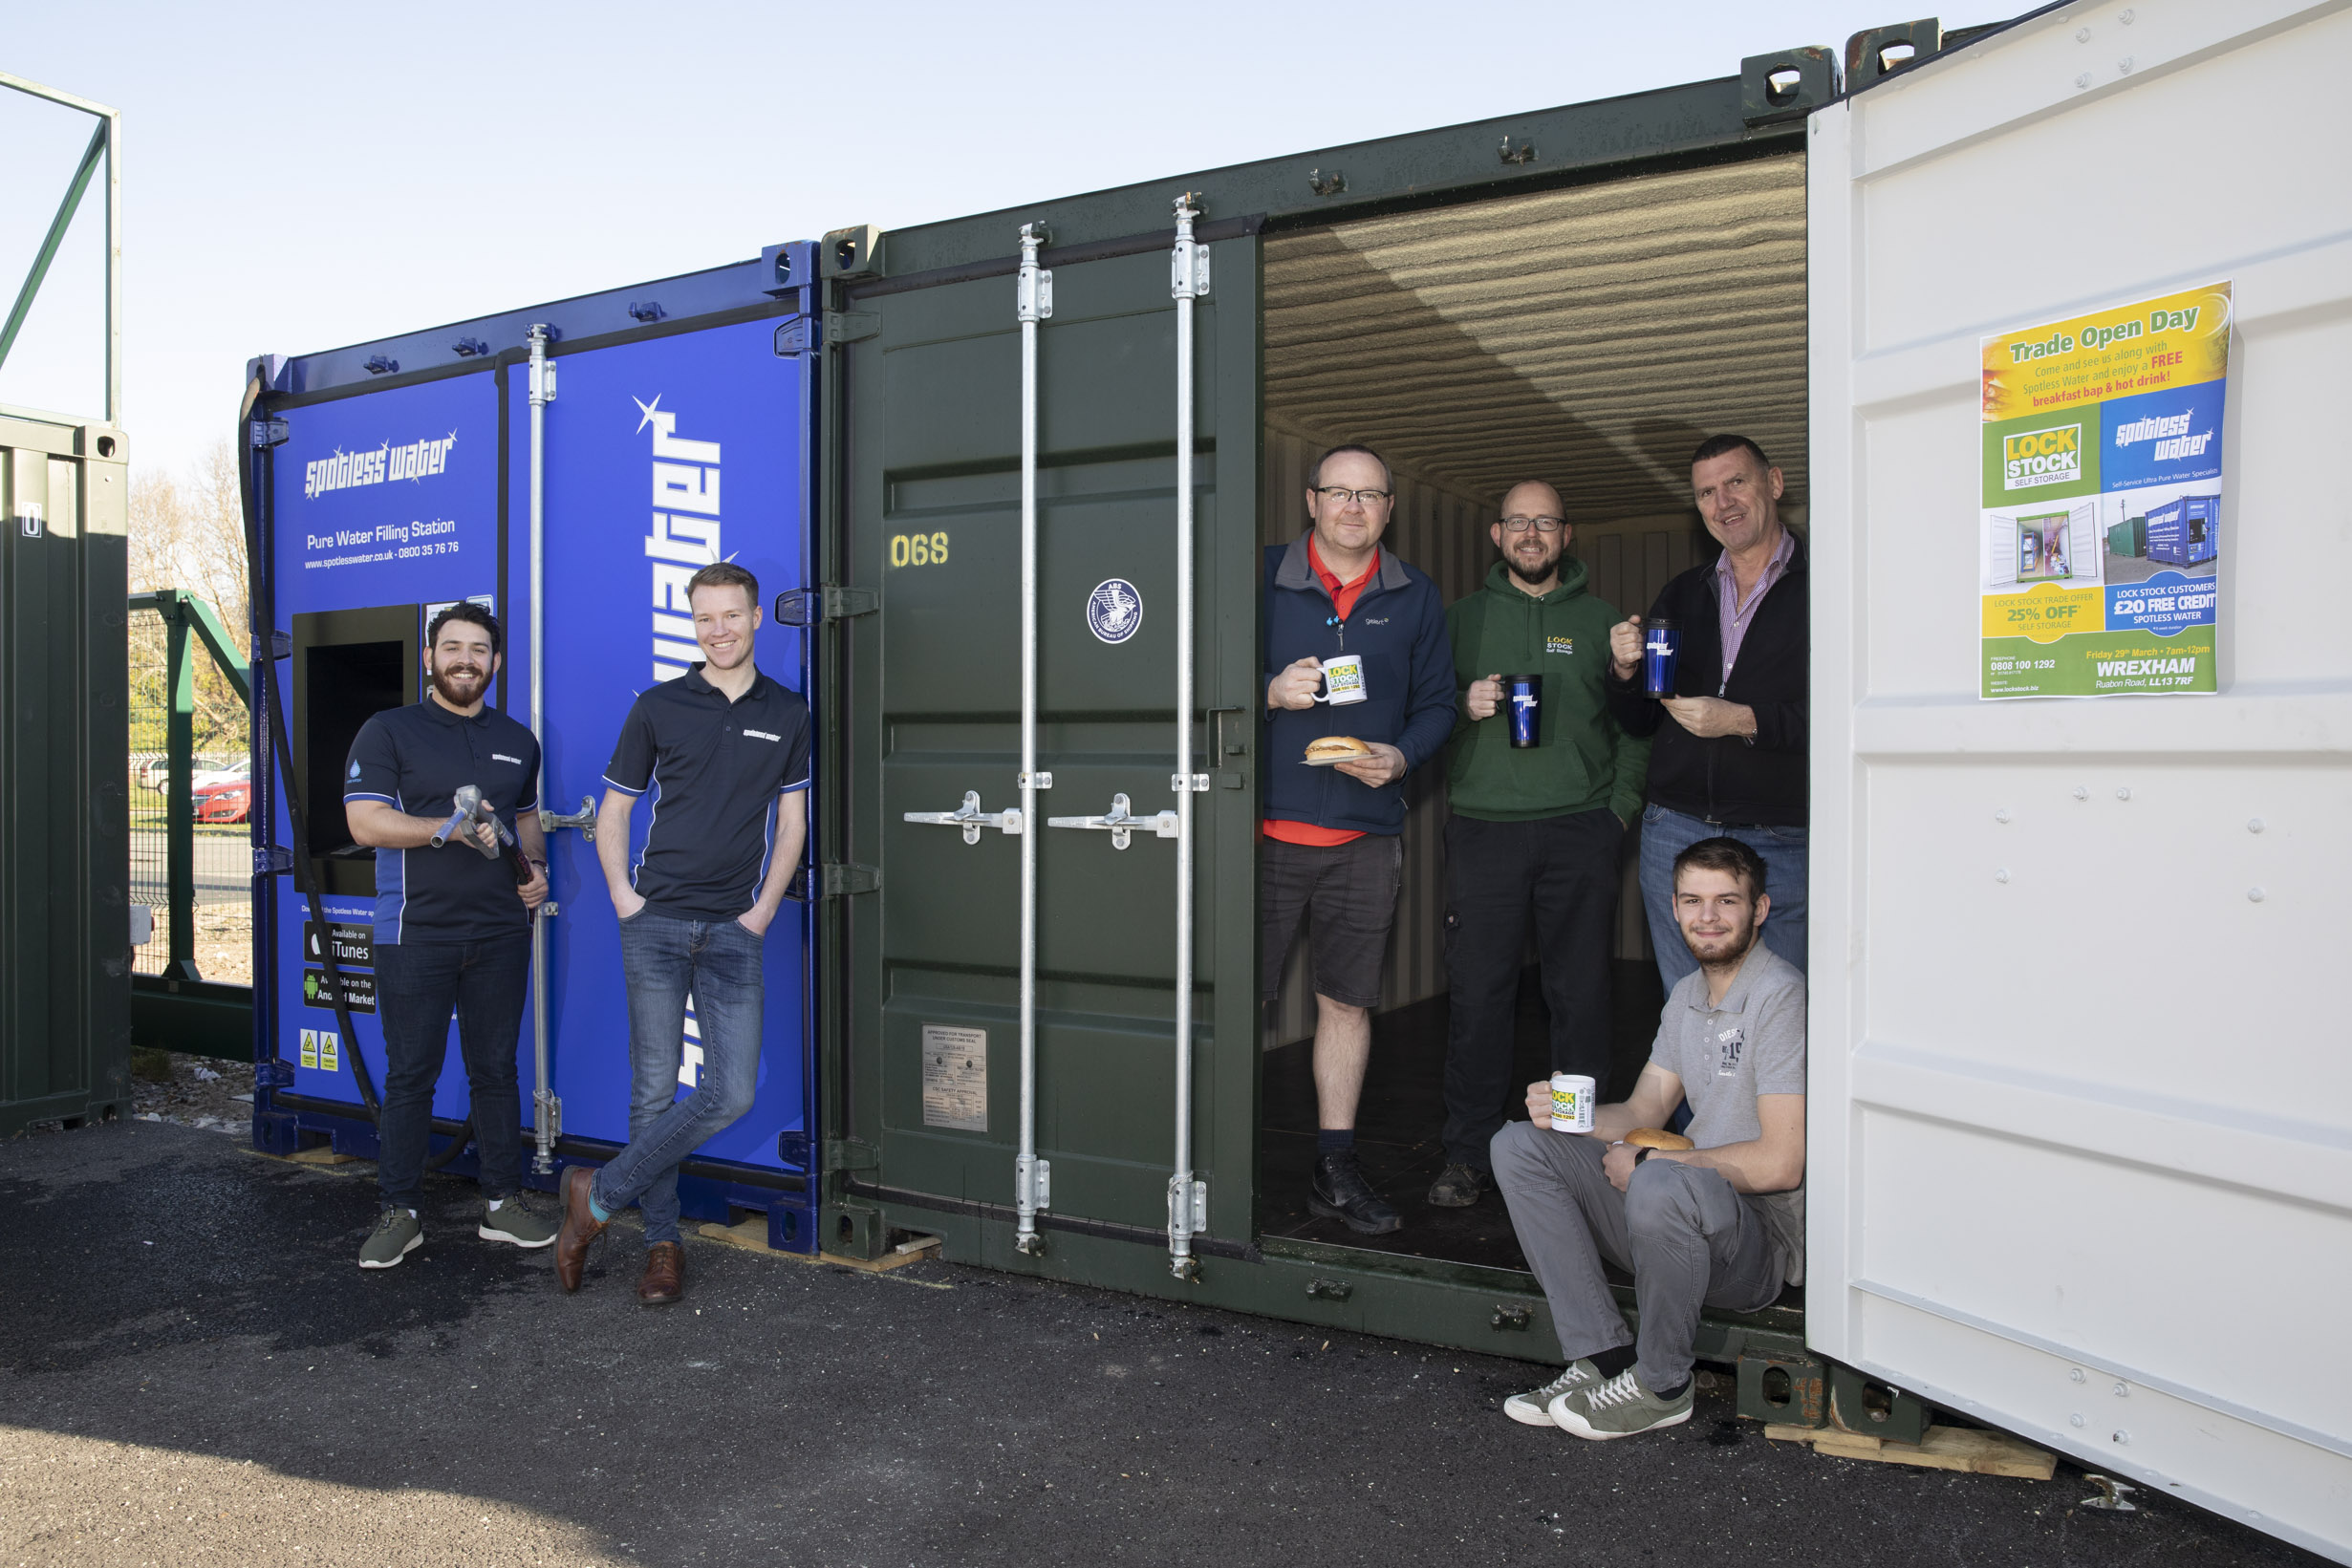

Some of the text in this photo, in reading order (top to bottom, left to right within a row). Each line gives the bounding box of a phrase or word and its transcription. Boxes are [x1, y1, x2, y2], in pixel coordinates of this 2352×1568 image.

[2010, 306, 2200, 363] Trade Open Day
[2035, 340, 2168, 376] Come and see us along with
[2023, 351, 2183, 397] Spotless Water and enjoy a FREE
[2033, 371, 2170, 407] breakfast bap & hot drink!
[2115, 413, 2191, 447] spotless
[2007, 427, 2077, 461] LOCK
[2154, 433, 2212, 462] water
[305, 436, 454, 498] spotless water
[2008, 451, 2077, 478] STOCK
[2015, 472, 2070, 487] SELF STORAGE
[2112, 480, 2142, 488] Self-Service
[2191, 468, 2217, 478] Specialists
[307, 518, 455, 550] Pure Water Filling Station
[305, 550, 393, 569] www.spotlesswater.co.uk
[399, 547, 421, 559] 0800
[421, 545, 433, 556] 35
[434, 544, 446, 555] 76
[447, 542, 459, 552] 76
[2117, 582, 2215, 598] LOCK STOCK CUSTOMERS
[1995, 593, 2093, 608] LOCK STOCK TRADE OFFER
[2113, 599, 2146, 615] £20
[2147, 597, 2175, 612] FREE
[2007, 608, 2040, 622] 25%
[2133, 612, 2202, 624] SPOTLESS WATER
[2037, 621, 2072, 630] STORAGE
[2086, 651, 2112, 659] Friday
[2131, 648, 2158, 657] March
[2166, 645, 2210, 655] 7am-12pm
[1328, 664, 1357, 677] LOCK
[1991, 659, 2056, 671] 0808 100 1292
[2096, 657, 2195, 677] WREXHAM
[1329, 674, 1359, 685] STOCK
[2095, 677, 2193, 688] Ruabon Road, LL13 7RF
[333, 907, 352, 915] Spotless
[332, 929, 357, 938] Available
[332, 940, 369, 959] iTunes
[360, 978, 372, 989] the
[349, 992, 375, 1005] Market
[1552, 1090, 1575, 1104] OCK
